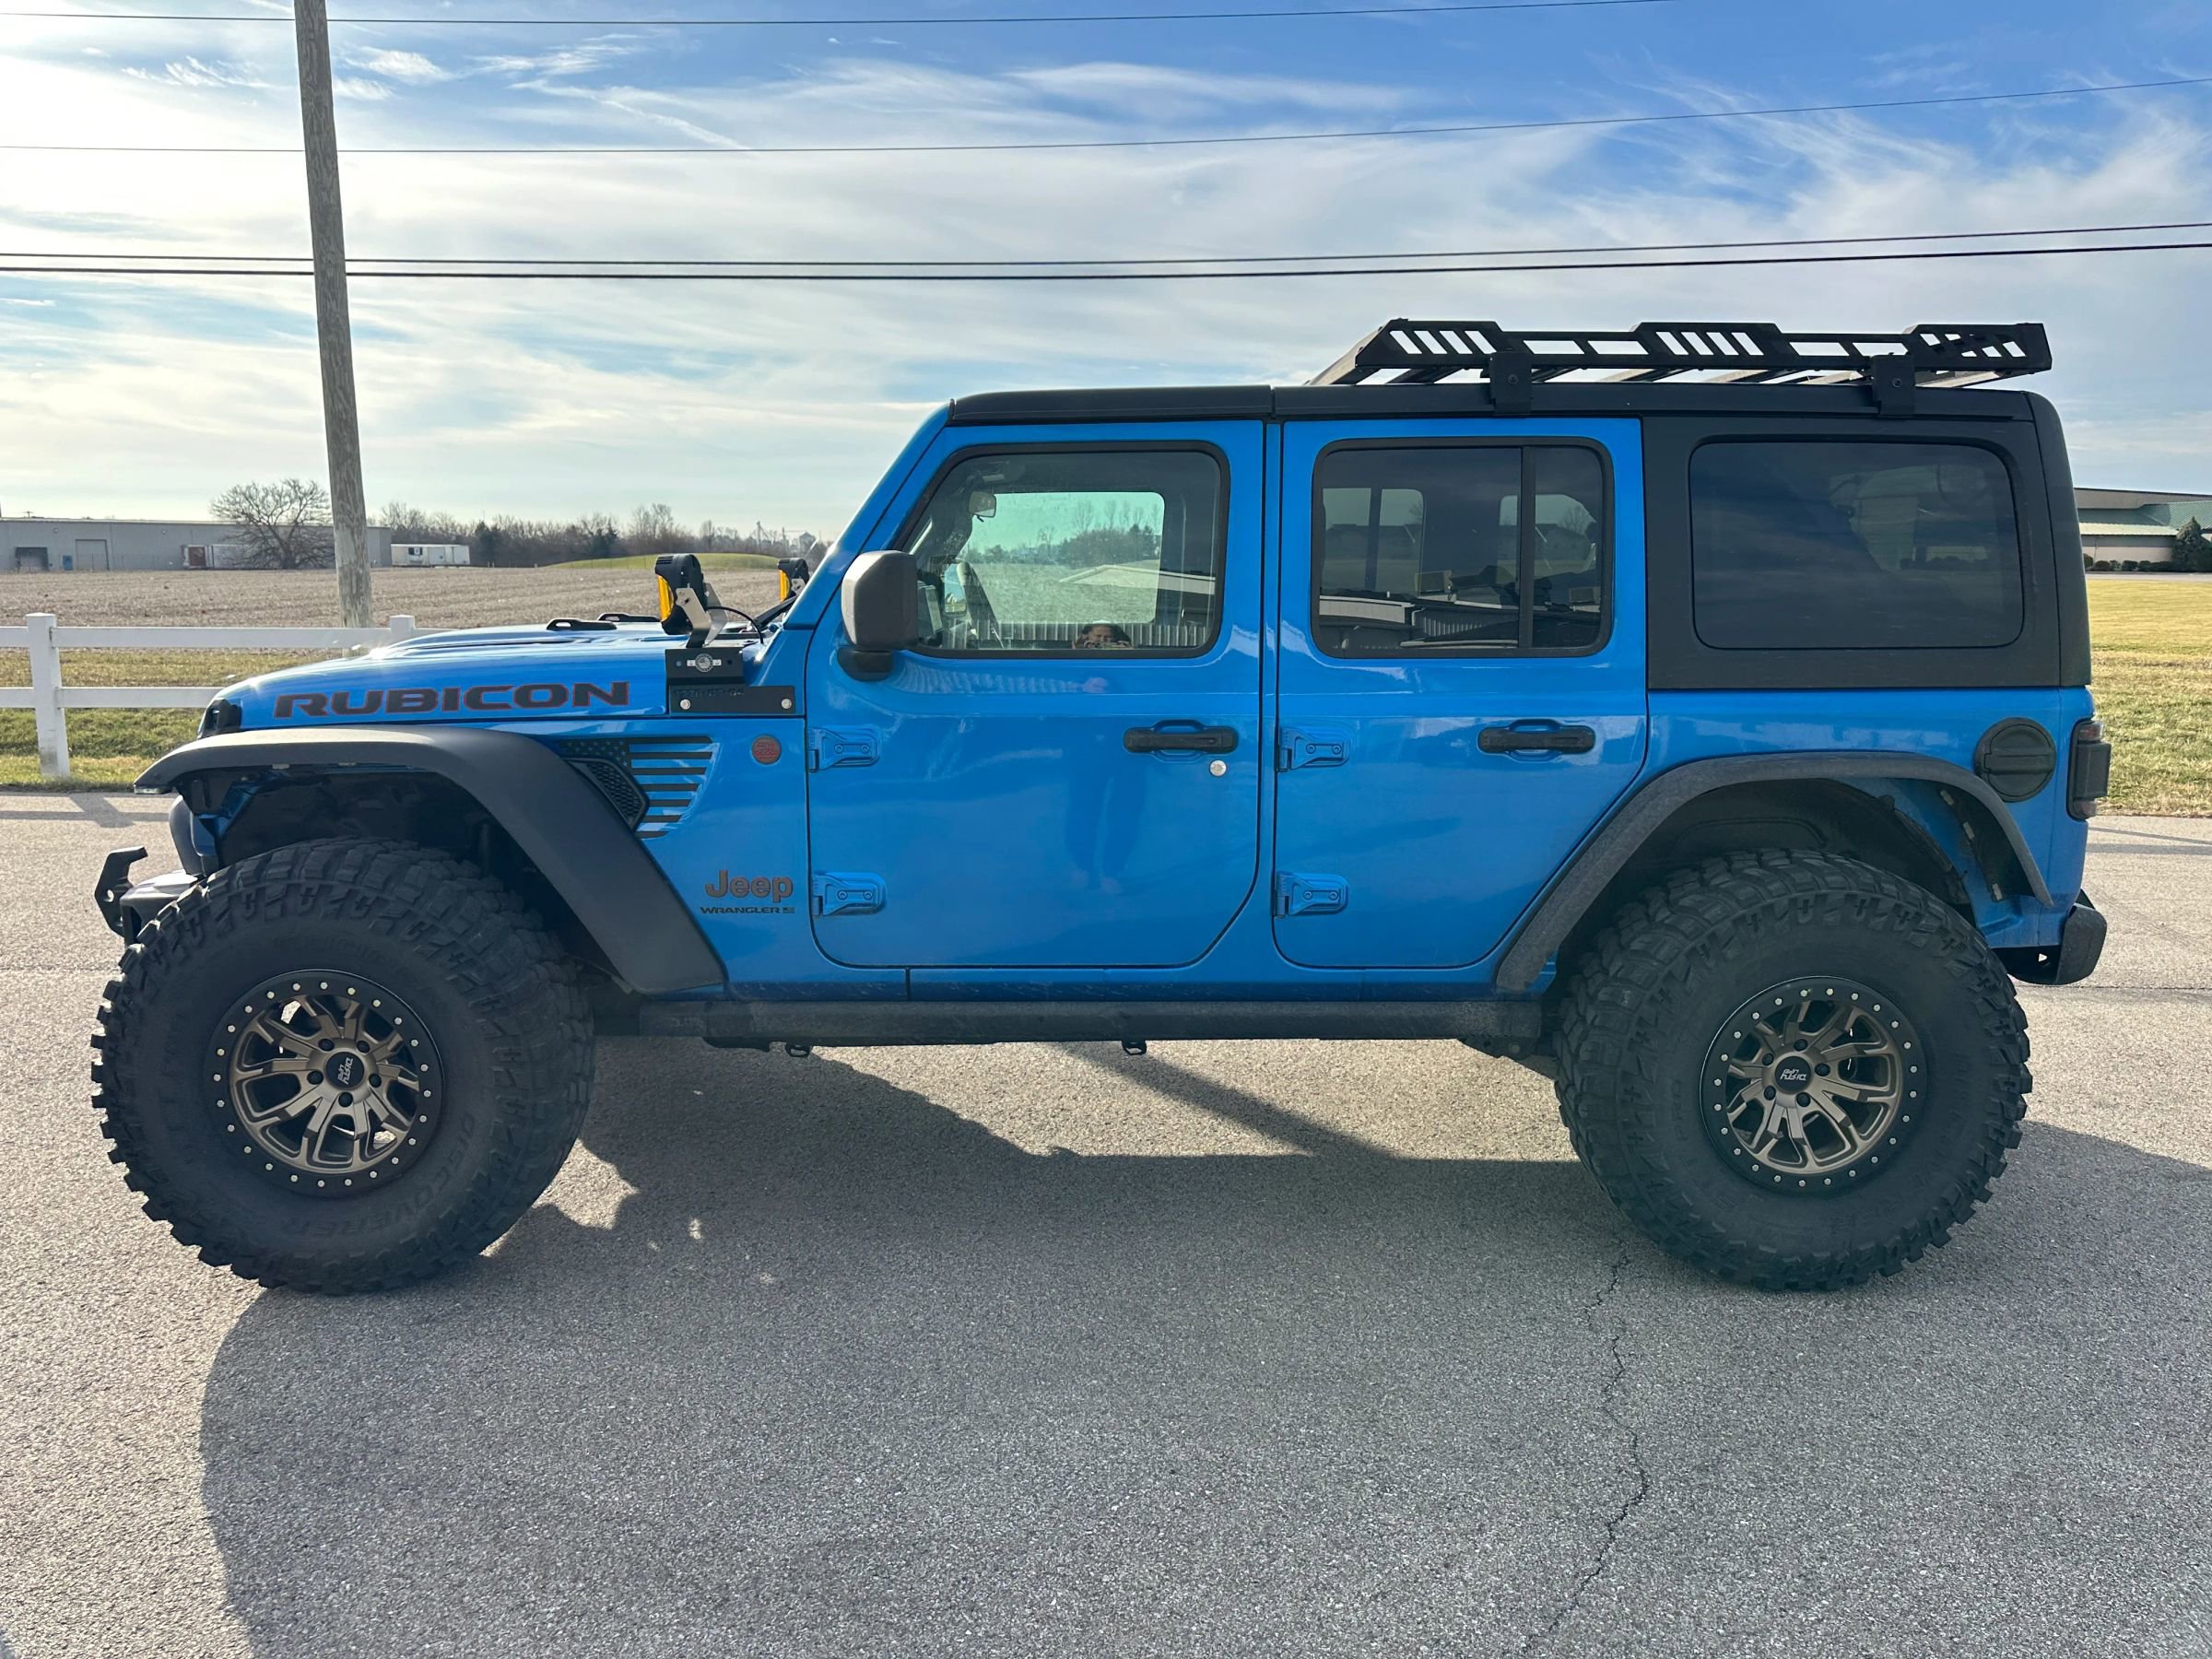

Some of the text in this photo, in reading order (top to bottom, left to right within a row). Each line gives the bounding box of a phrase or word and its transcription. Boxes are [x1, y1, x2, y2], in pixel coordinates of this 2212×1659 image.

[274, 680, 630, 719] RUBICON
[704, 869, 794, 903] Jeep
[700, 906, 781, 914] WRANGLER
